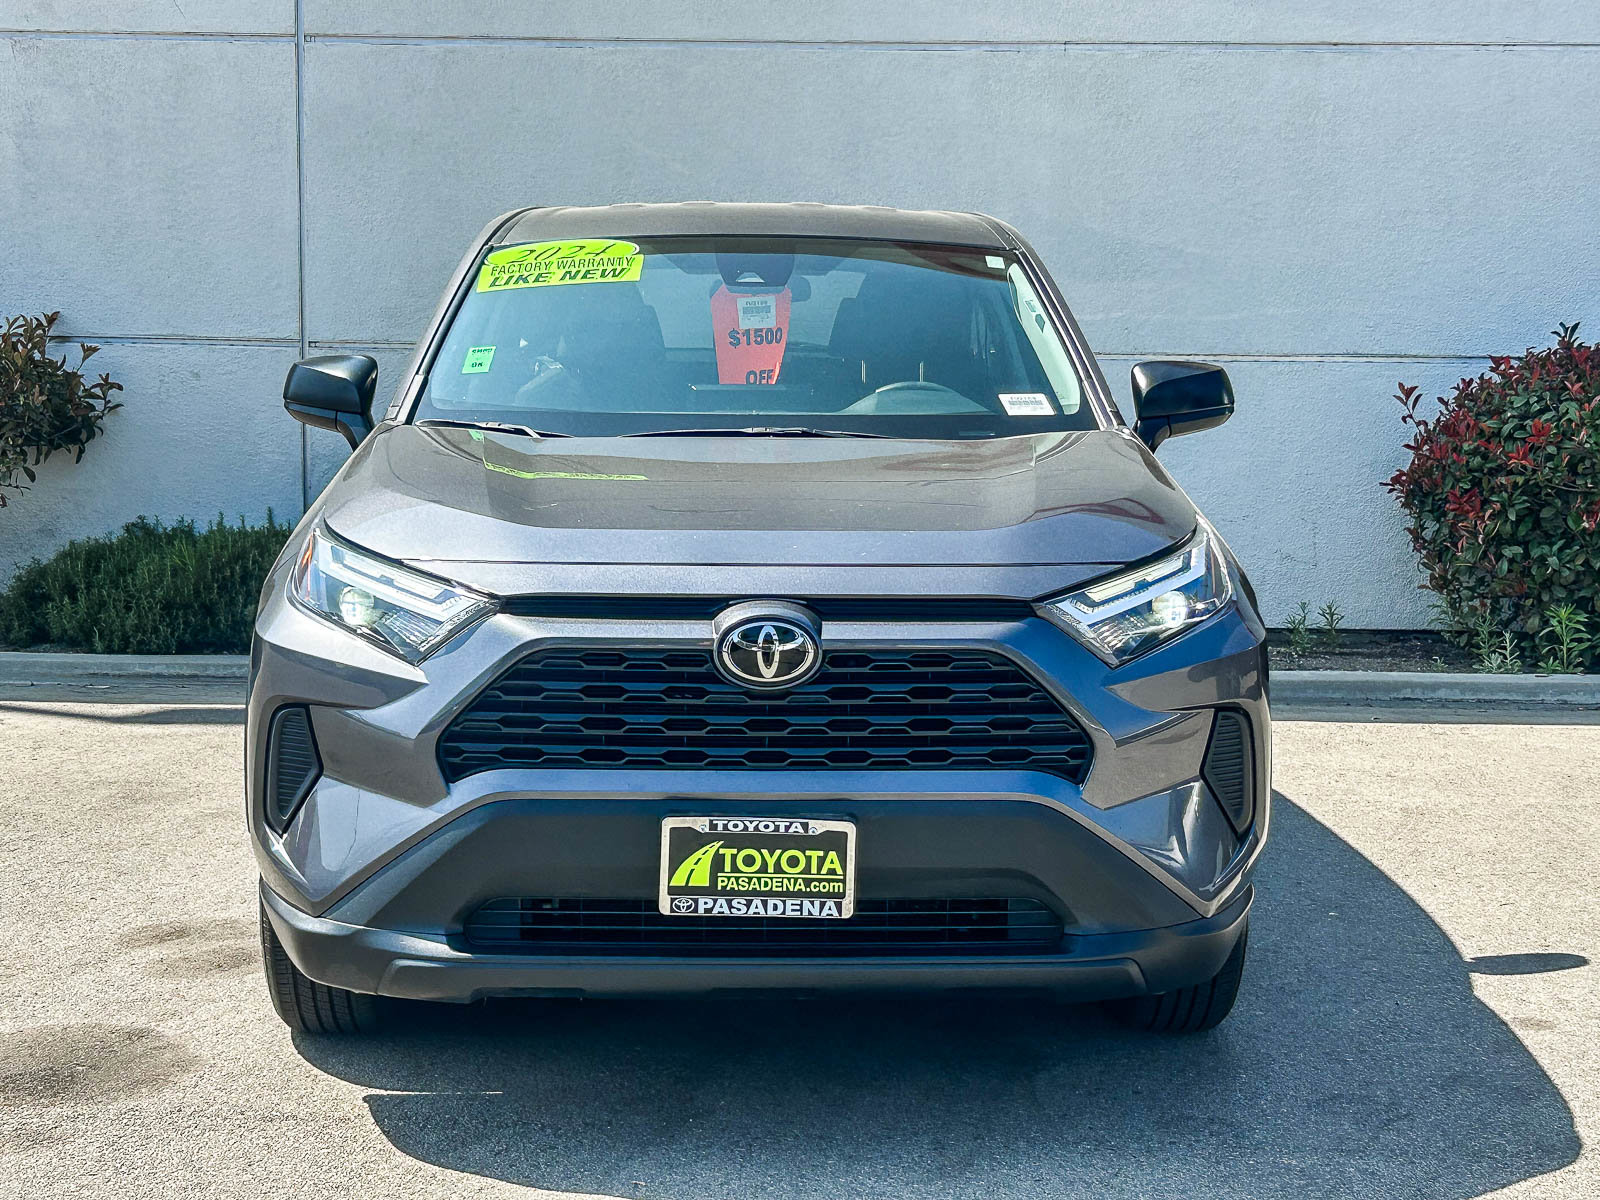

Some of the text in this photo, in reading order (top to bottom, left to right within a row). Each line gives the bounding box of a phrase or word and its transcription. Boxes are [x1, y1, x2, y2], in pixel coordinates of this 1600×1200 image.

[490, 256, 636, 276] FACTORY WARRANTY
[489, 267, 630, 288] LIKE NEW
[728, 327, 783, 349] $1500
[745, 369, 775, 385] OFF
[712, 820, 805, 834] TOYOTA
[718, 848, 843, 875] TOYOTA
[717, 877, 844, 893] PASADENA.com
[697, 898, 839, 917] PASADENA
